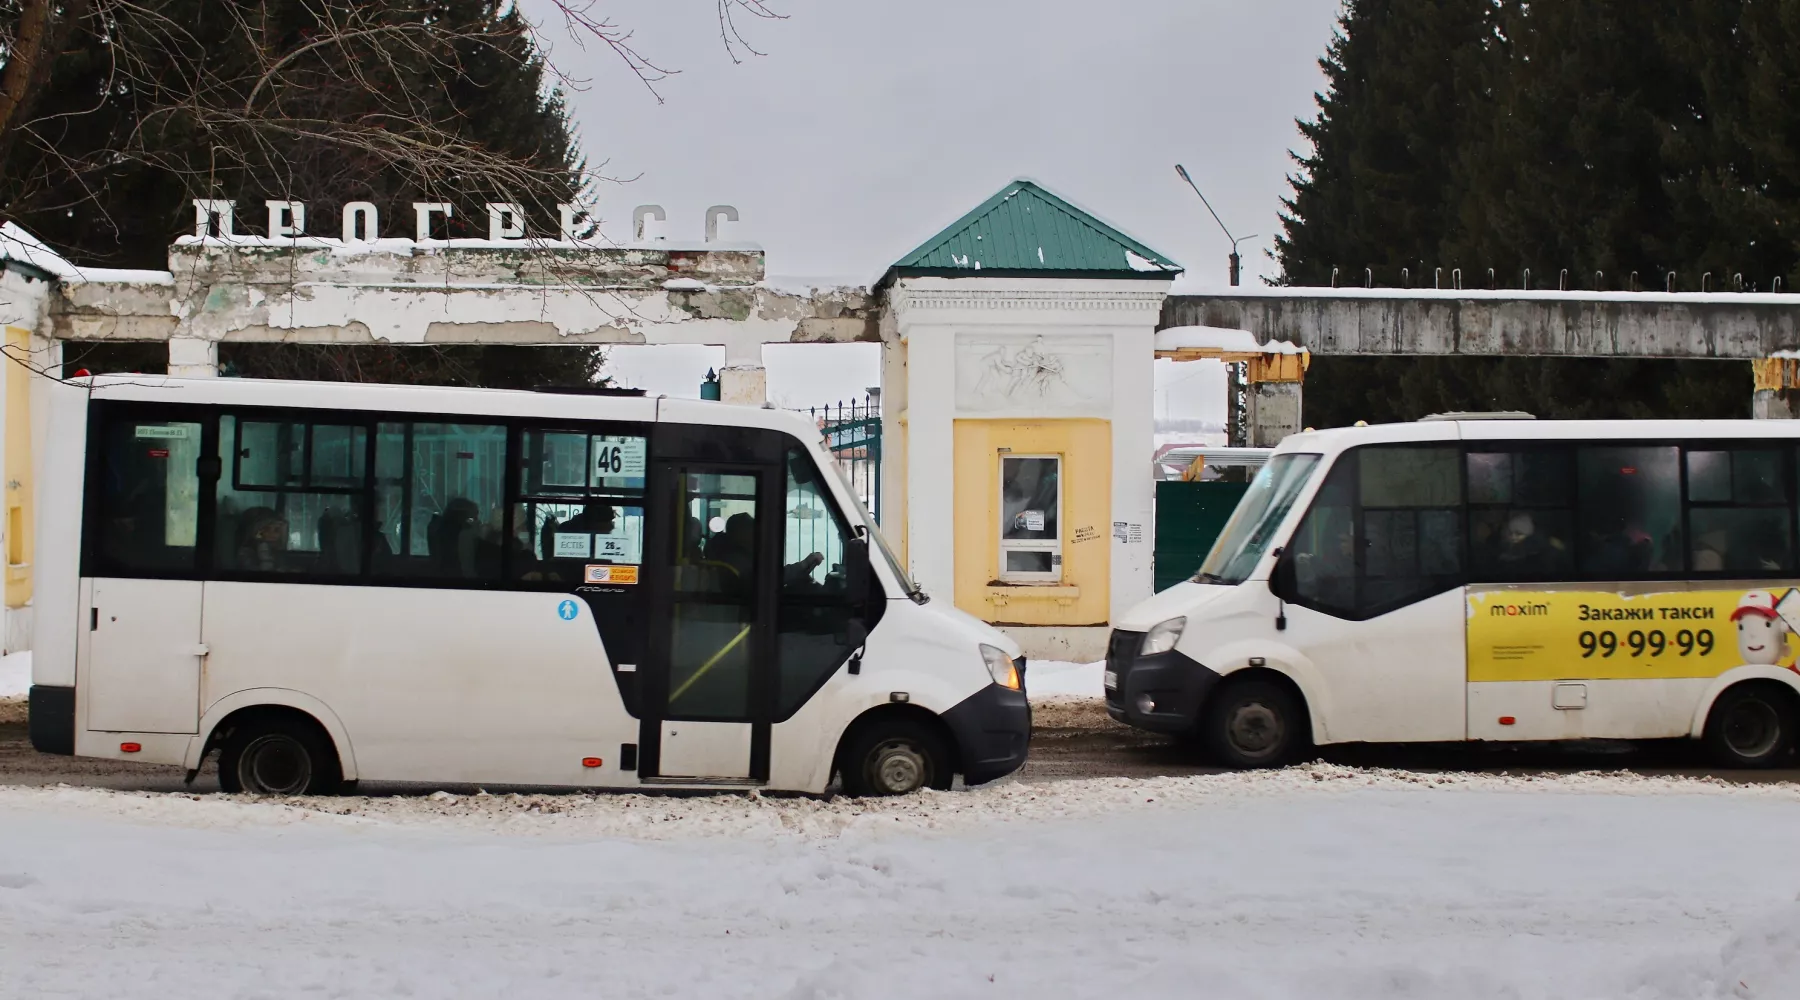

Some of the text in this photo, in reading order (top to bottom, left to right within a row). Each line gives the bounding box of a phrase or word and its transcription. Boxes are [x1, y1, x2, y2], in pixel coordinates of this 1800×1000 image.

[193, 199, 739, 243] ПРОГРЕСС
[598, 446, 621, 473] 46
[1578, 604, 1714, 621] Закажи такси
